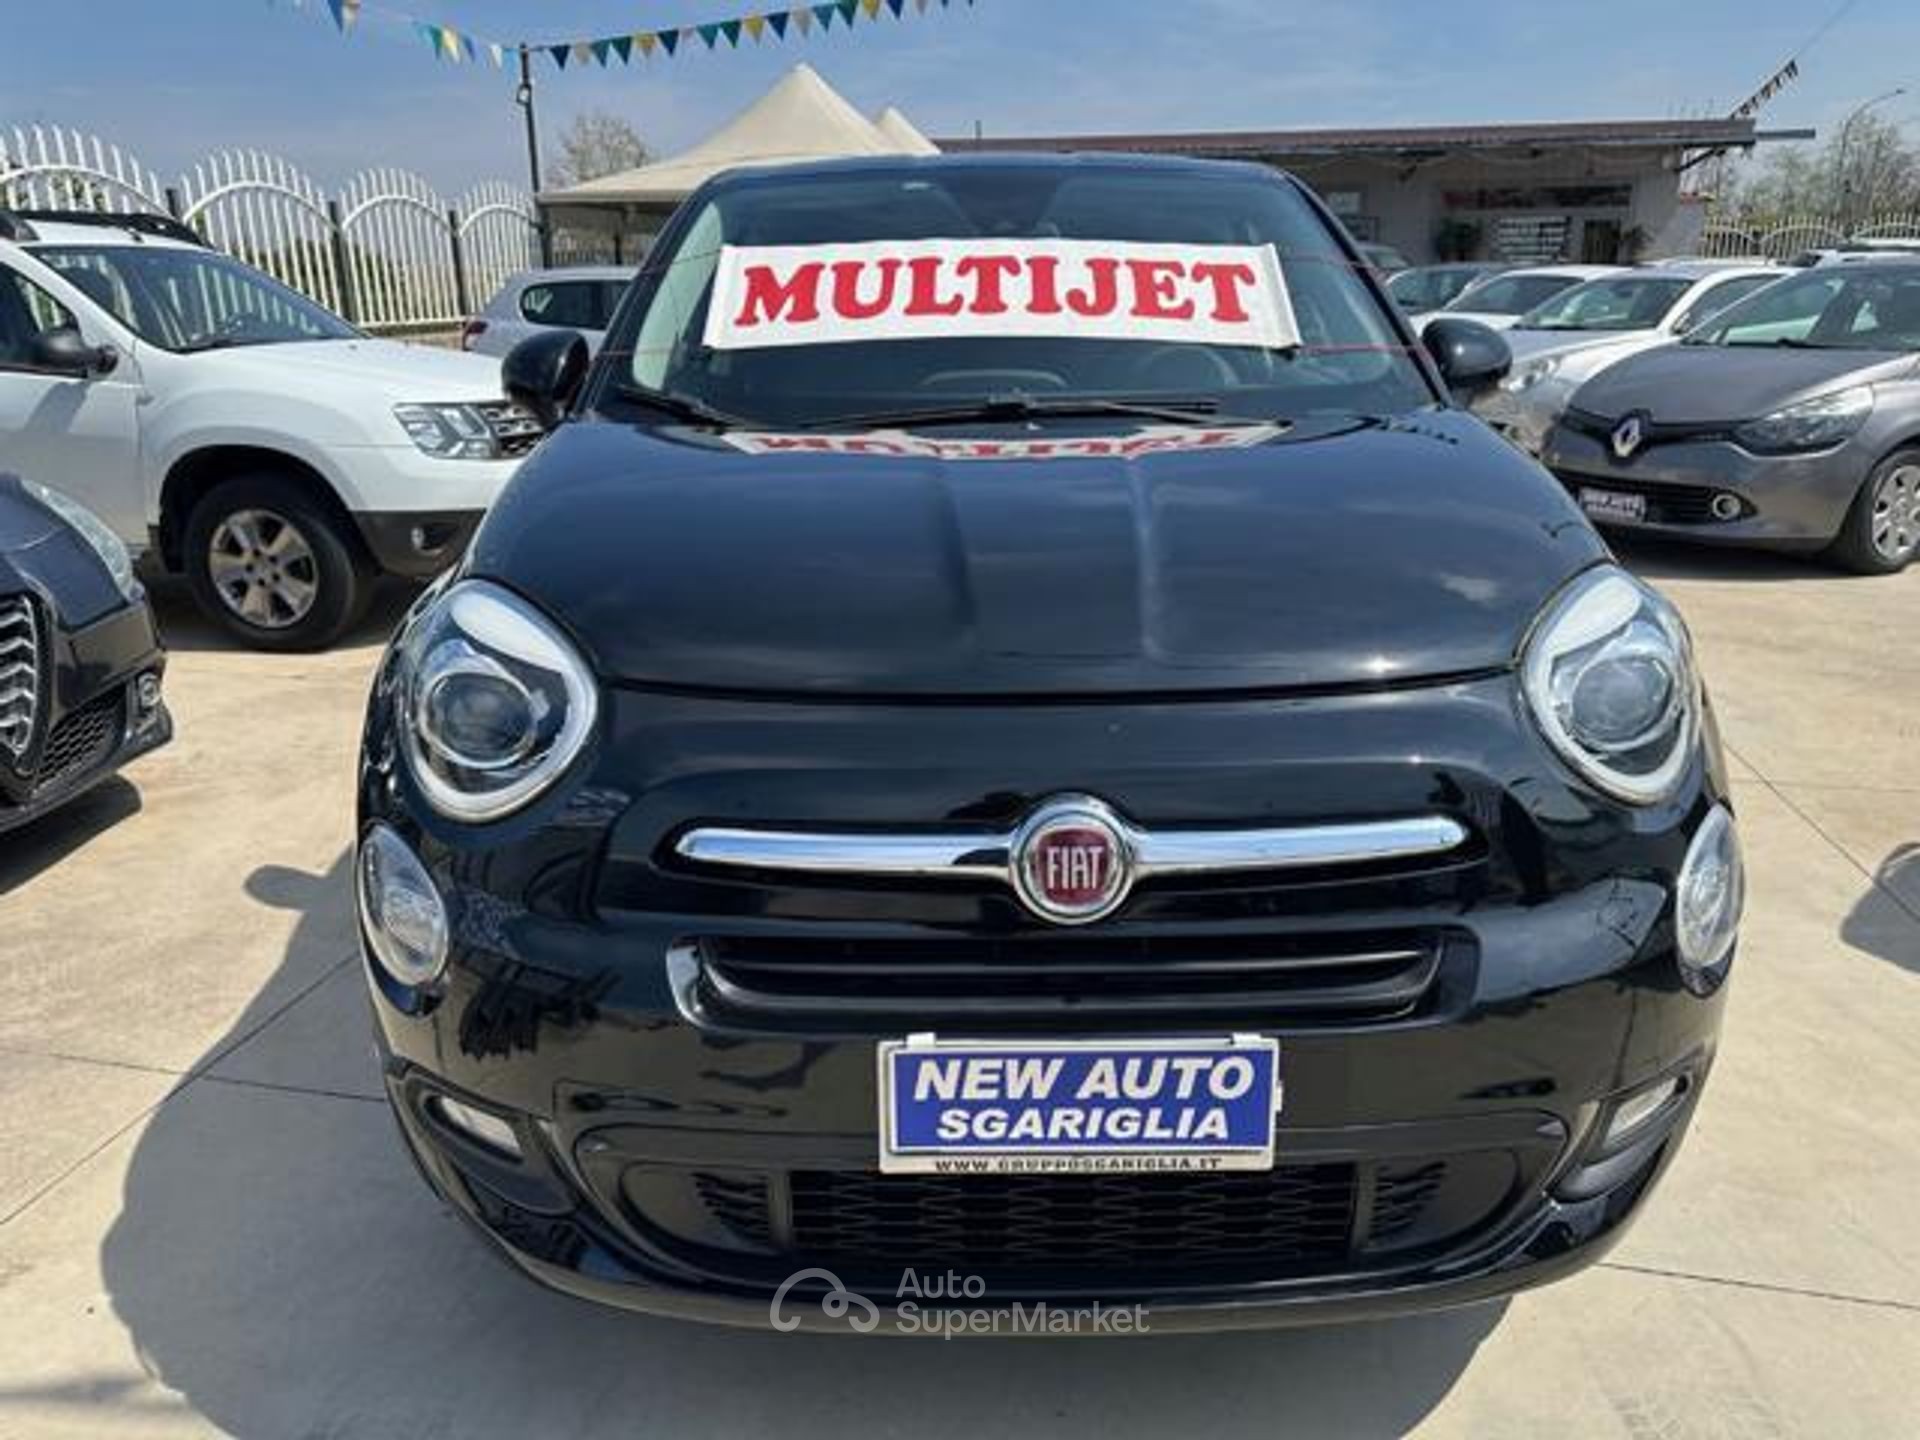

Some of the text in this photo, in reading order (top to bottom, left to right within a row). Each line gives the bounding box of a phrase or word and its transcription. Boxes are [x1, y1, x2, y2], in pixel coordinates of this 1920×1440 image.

[734, 255, 1256, 327] MULTIJET
[1046, 846, 1104, 890] FIAT
[914, 1056, 1255, 1100] NEW AUTO
[936, 1107, 1230, 1140] SGARIGLIA
